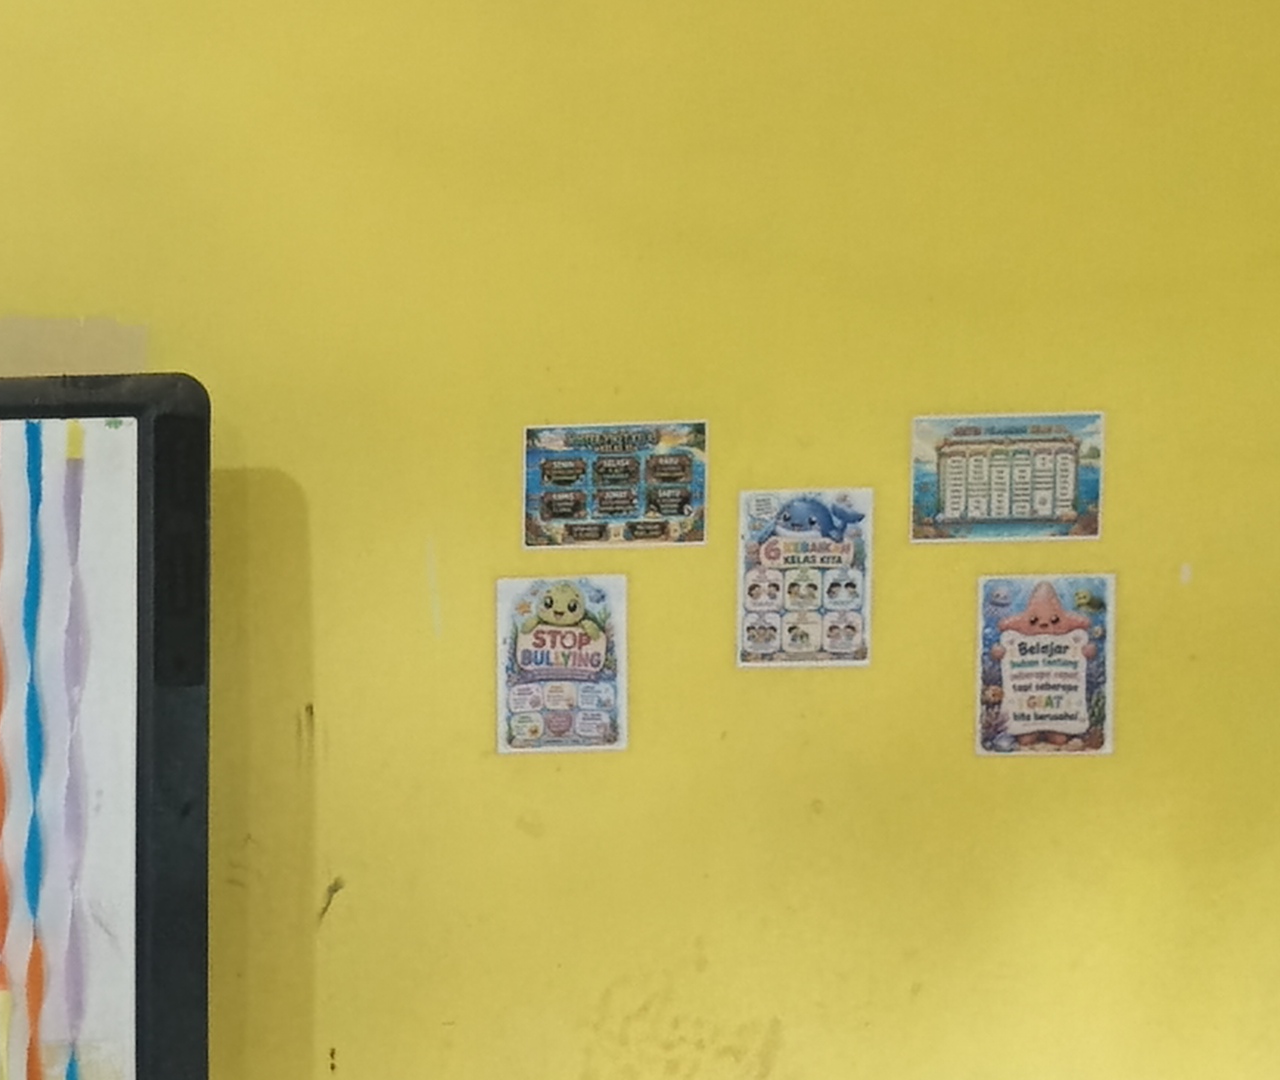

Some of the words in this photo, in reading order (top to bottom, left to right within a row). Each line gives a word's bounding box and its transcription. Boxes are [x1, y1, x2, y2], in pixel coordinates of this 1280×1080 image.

[763, 540, 781, 561] 6
[783, 555, 816, 564] KELAS
[820, 555, 842, 564] KITA
[532, 629, 591, 650] STOP
[1018, 641, 1069, 657] Belajar
[521, 649, 601, 668] BULLYING
